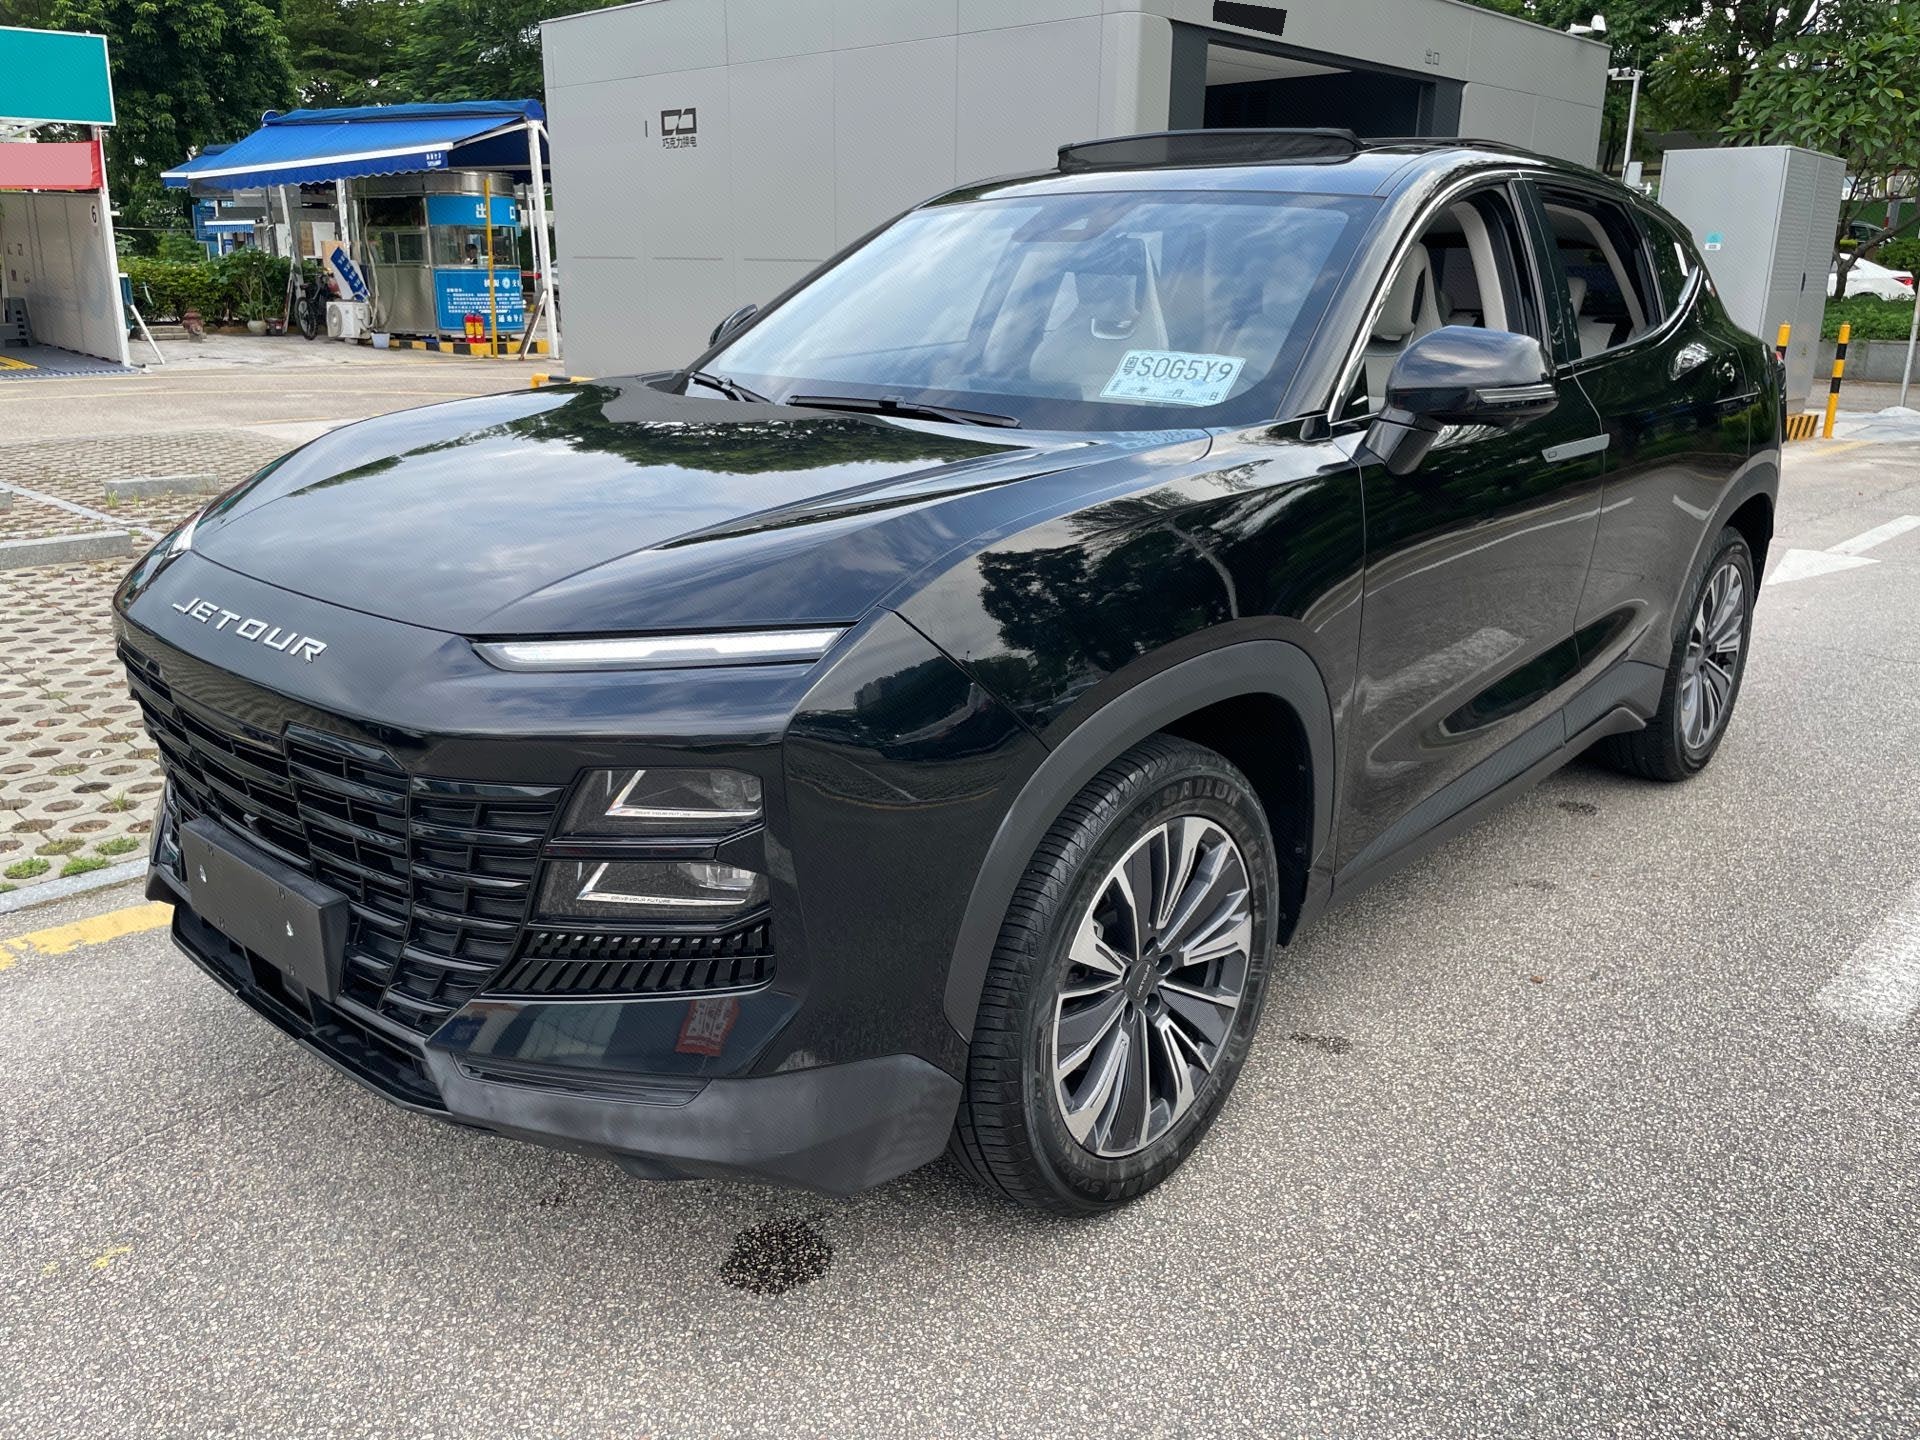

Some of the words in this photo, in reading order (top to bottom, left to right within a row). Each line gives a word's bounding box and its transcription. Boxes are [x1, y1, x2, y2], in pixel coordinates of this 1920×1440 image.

[1425, 48, 1439, 65] 出口
[662, 136, 697, 149] 巧克力换电
[475, 203, 516, 220] 出口
[172, 598, 328, 663] JETOUR
